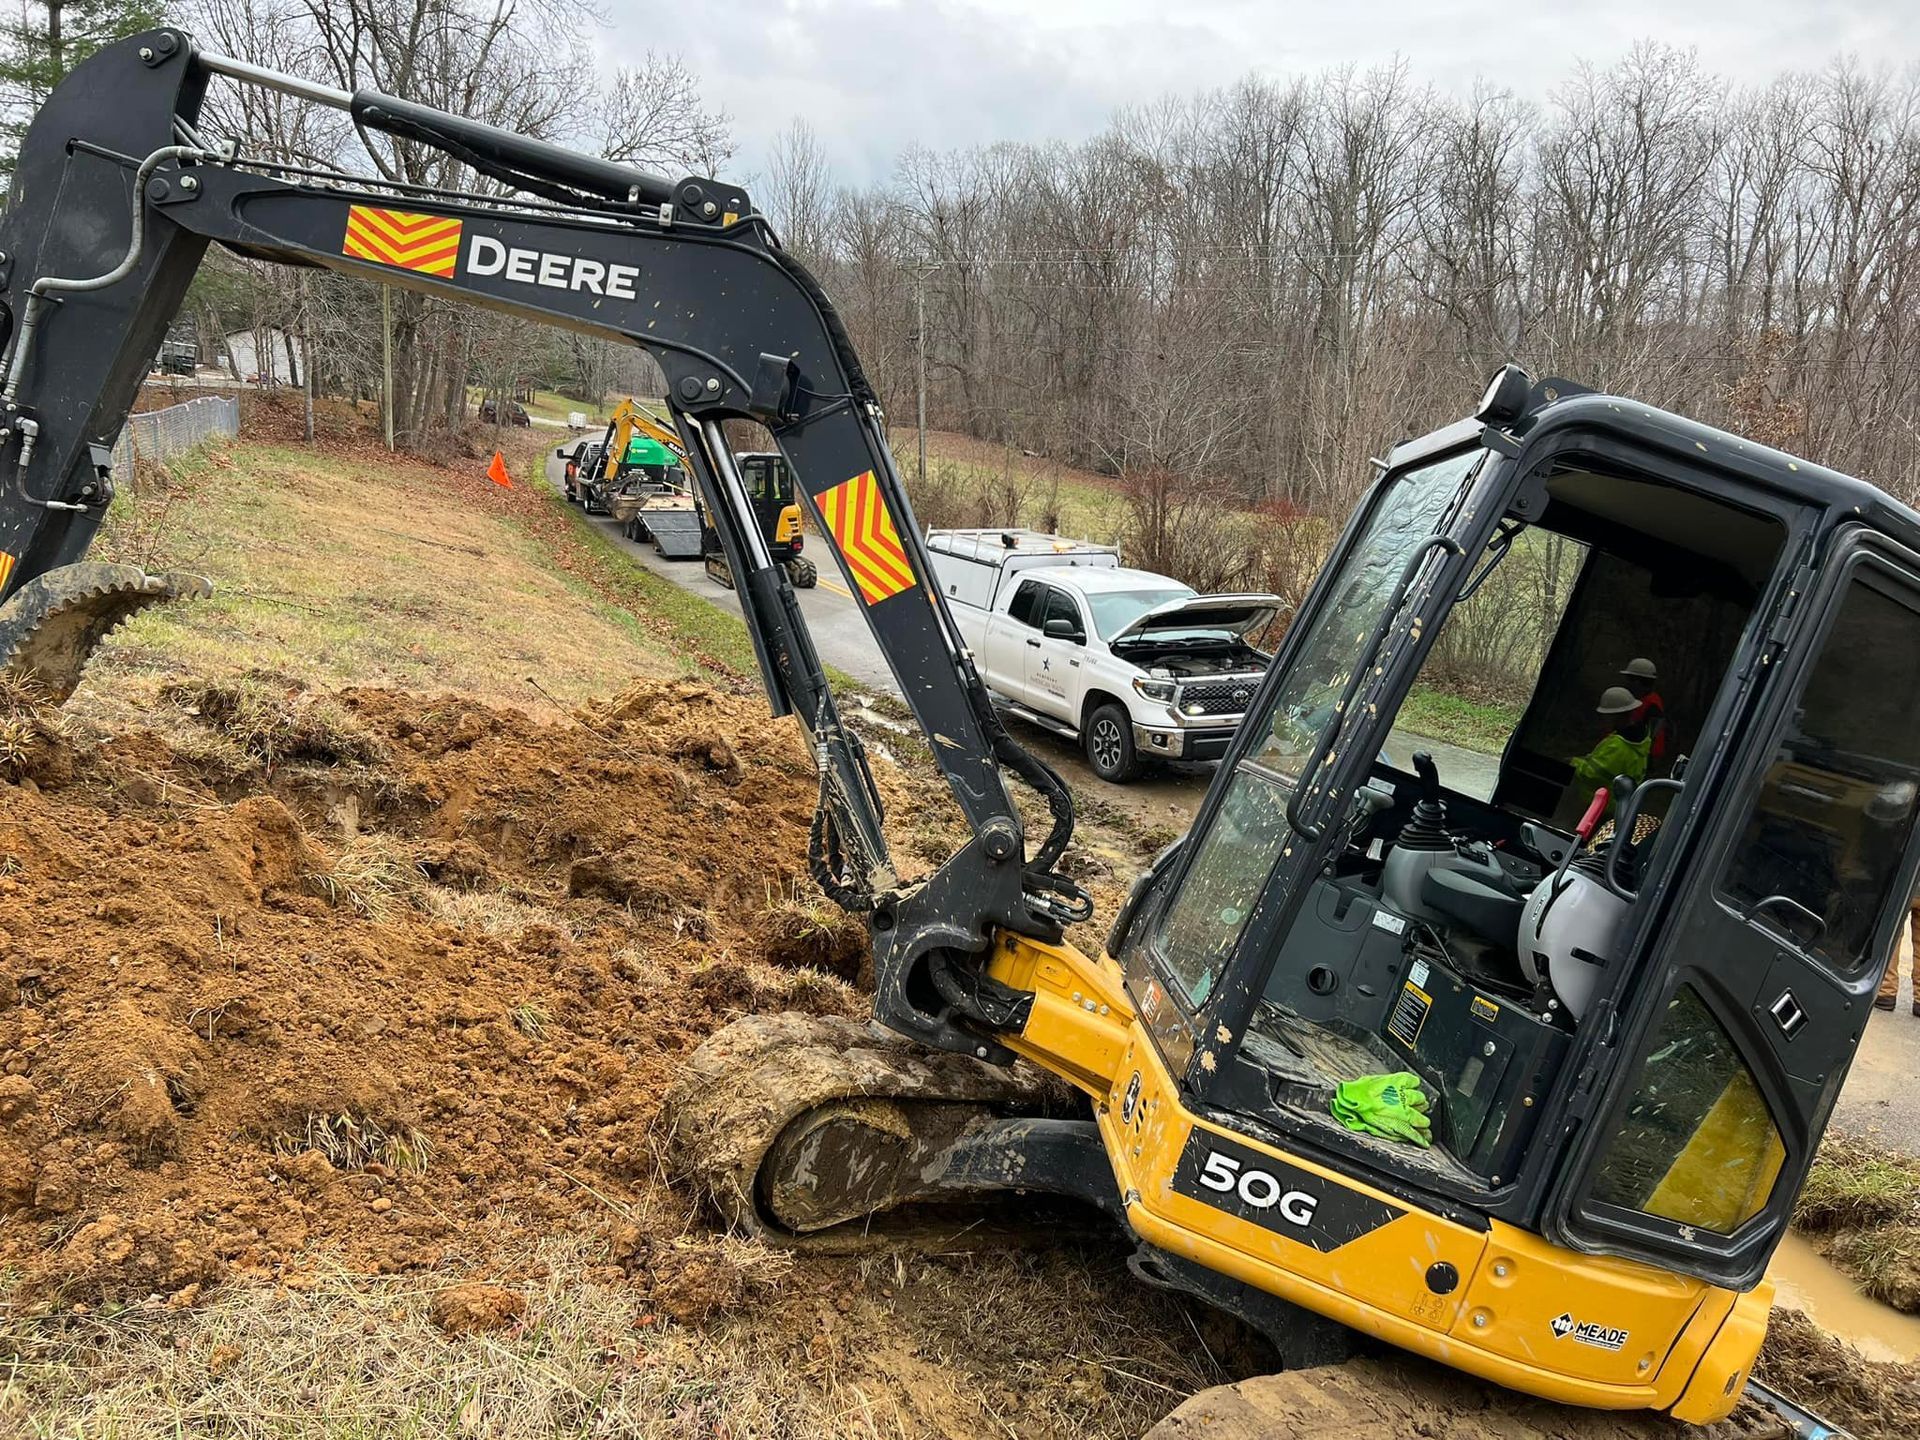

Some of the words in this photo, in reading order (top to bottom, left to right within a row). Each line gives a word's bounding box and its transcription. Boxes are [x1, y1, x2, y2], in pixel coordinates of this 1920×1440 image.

[467, 235, 640, 300] DEERE
[1200, 1151, 1318, 1227] 50G
[1575, 1321, 1628, 1344] MEADE
